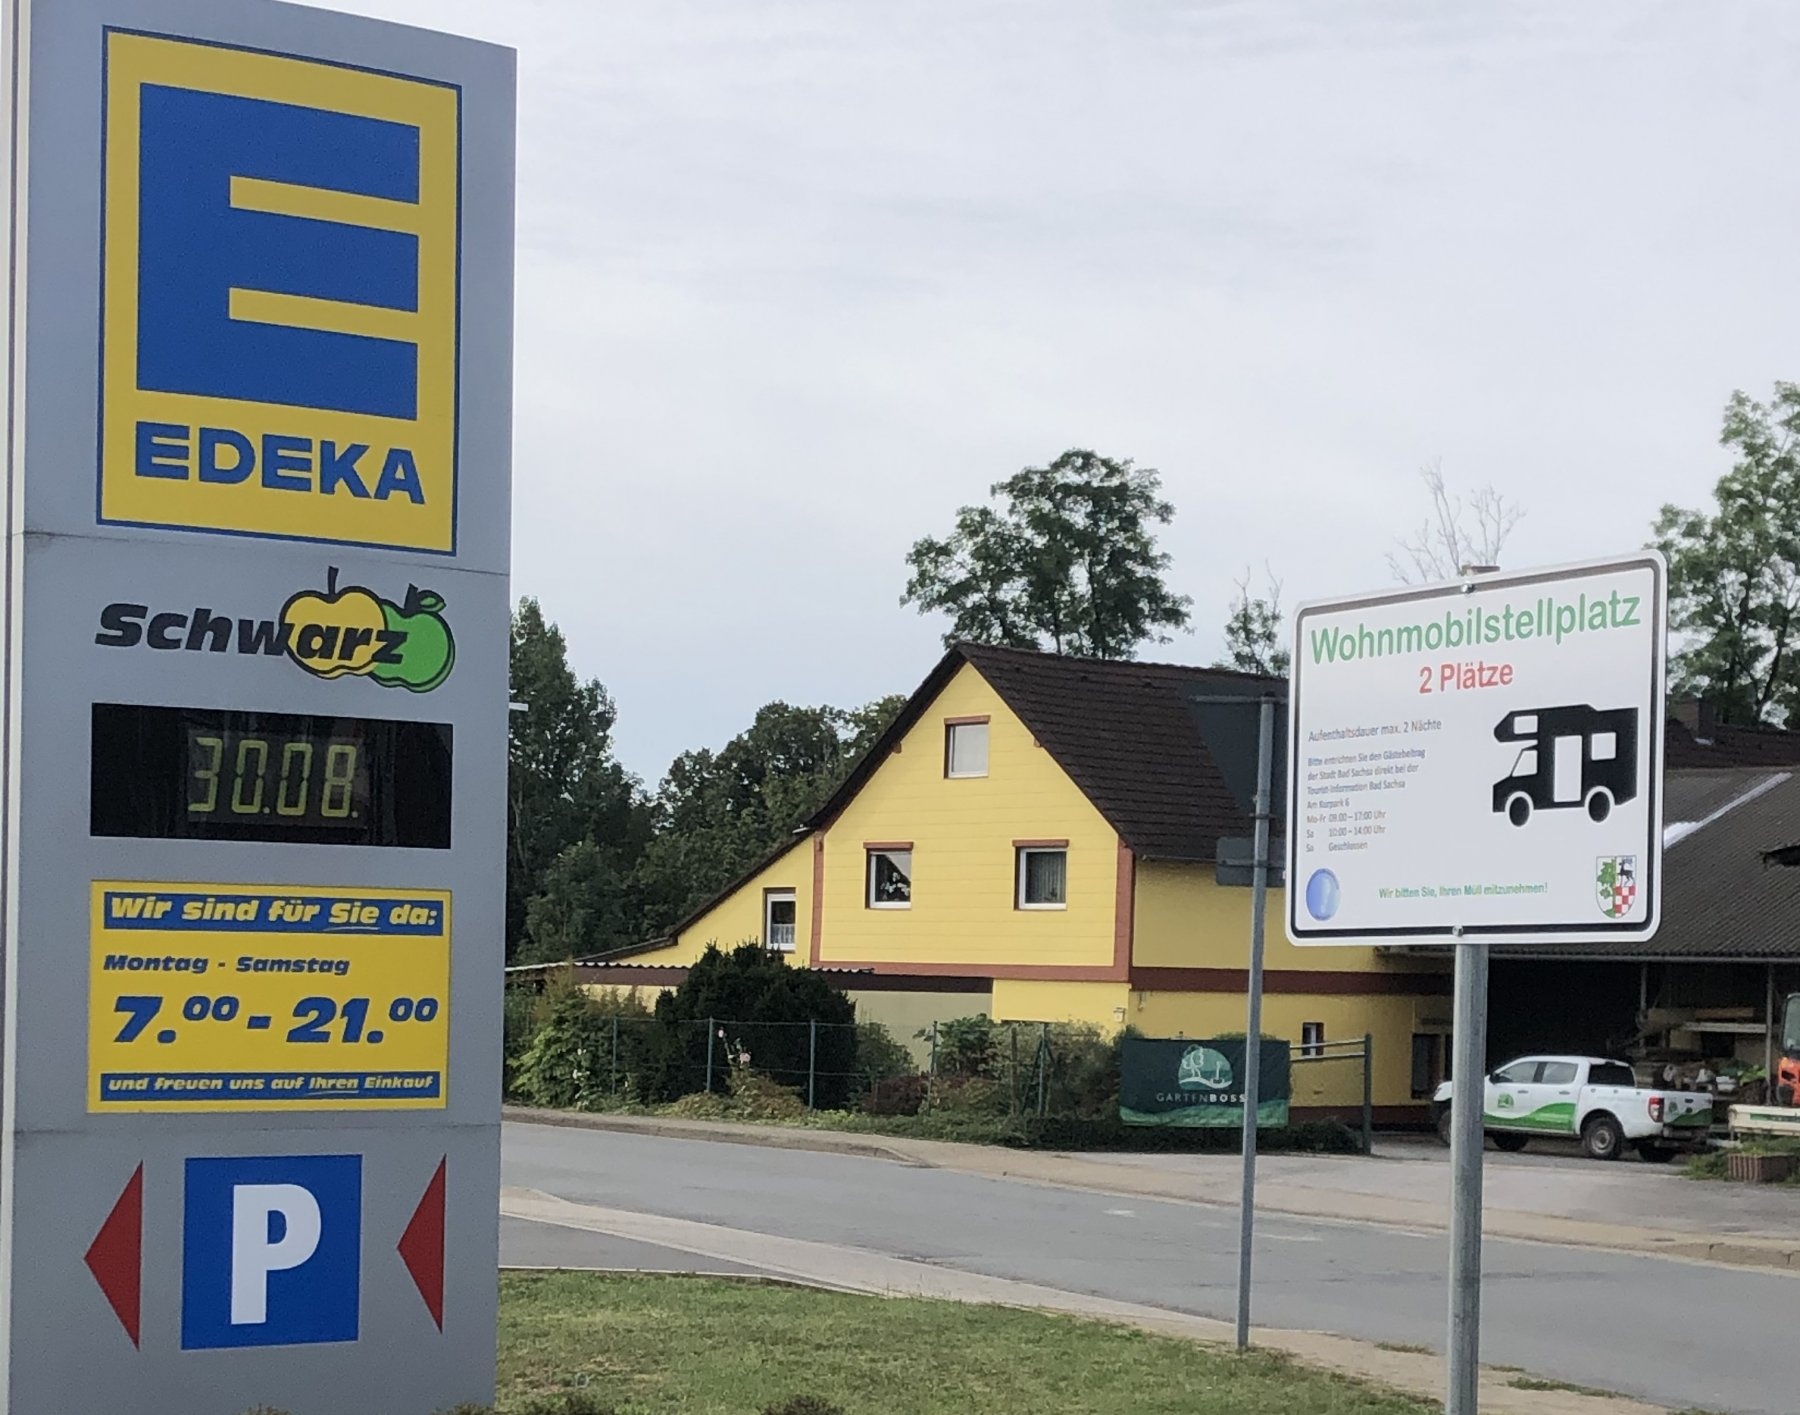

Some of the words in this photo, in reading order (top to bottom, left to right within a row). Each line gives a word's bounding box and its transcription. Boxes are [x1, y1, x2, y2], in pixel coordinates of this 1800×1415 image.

[135, 82, 420, 421] E
[135, 421, 426, 505] EDEKA
[95, 603, 408, 665] Schwarz
[1311, 590, 1641, 664] Wohnmobilstellplatz
[1419, 666, 1432, 694] 2
[1440, 661, 1514, 692] Plätze
[1308, 726, 1379, 742] Aufenthaltsdauer
[1380, 724, 1401, 736] max.
[1403, 721, 1409, 733] 2
[1411, 719, 1442, 733] Nächte
[1358, 752, 1368, 762] Sie
[1337, 769, 1351, 779] Bad
[1369, 780, 1382, 790] Bad
[1379, 887, 1393, 899] Wir
[1395, 886, 1419, 898] bitten
[1421, 885, 1437, 898] Sie,
[1484, 882, 1548, 896] mitzunehmen!
[111, 896, 172, 919] Wir
[182, 897, 259, 922] sind
[268, 899, 320, 924] für
[327, 903, 381, 926] Sie
[389, 905, 438, 926] da:
[103, 954, 208, 975] Montag
[236, 956, 351, 976] Samstag
[107, 1076, 149, 1091] und
[154, 1076, 229, 1091] freuen
[229, 1076, 265, 1090] uns
[271, 1075, 305, 1090] auf
[308, 1075, 359, 1090] Ihren
[363, 1074, 434, 1089] Einkauf
[231, 1183, 322, 1325] P
